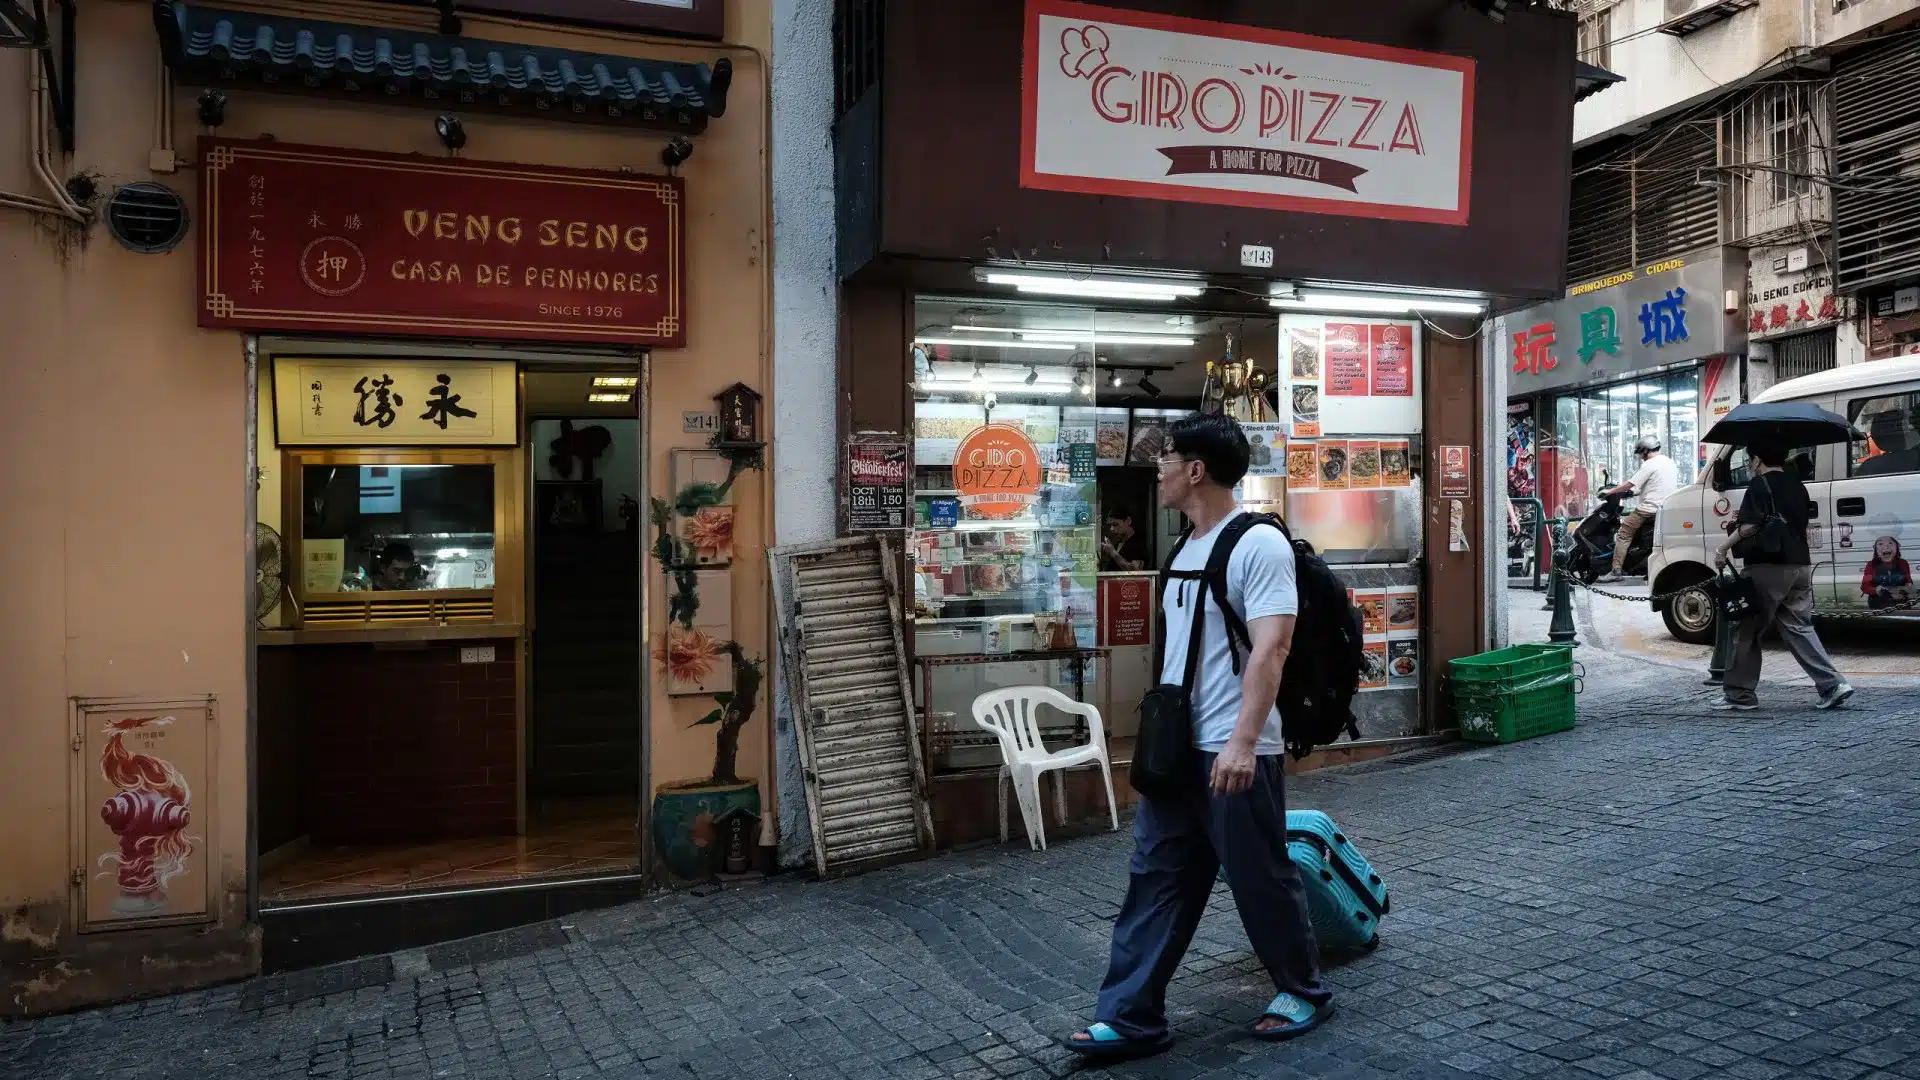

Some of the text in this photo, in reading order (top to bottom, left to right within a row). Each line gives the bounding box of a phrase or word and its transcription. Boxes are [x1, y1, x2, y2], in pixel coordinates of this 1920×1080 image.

[1092, 67, 1426, 156] GIRO PIZZA
[1209, 149, 1321, 180] A HOME FOR PIZZA
[403, 208, 650, 254] VENG SENG
[315, 250, 348, 283] 押
[1254, 250, 1271, 264] 143
[391, 259, 661, 295] CASA DE PENHORES
[1571, 259, 1685, 296] BRINQUEDOS CIDADE
[1763, 286, 1789, 302] SENG
[585, 305, 623, 319] 1976
[1512, 286, 1690, 376] 玩具城
[353, 373, 477, 430] 永勝
[699, 415, 719, 429] 141
[850, 458, 905, 478] Oktoberfest
[969, 448, 1027, 468] GIRO
[962, 468, 1030, 488] PIZZA
[852, 487, 876, 496] OCT
[882, 486, 904, 494] Ticket
[852, 495, 876, 507] 18th
[882, 495, 902, 506] 150
